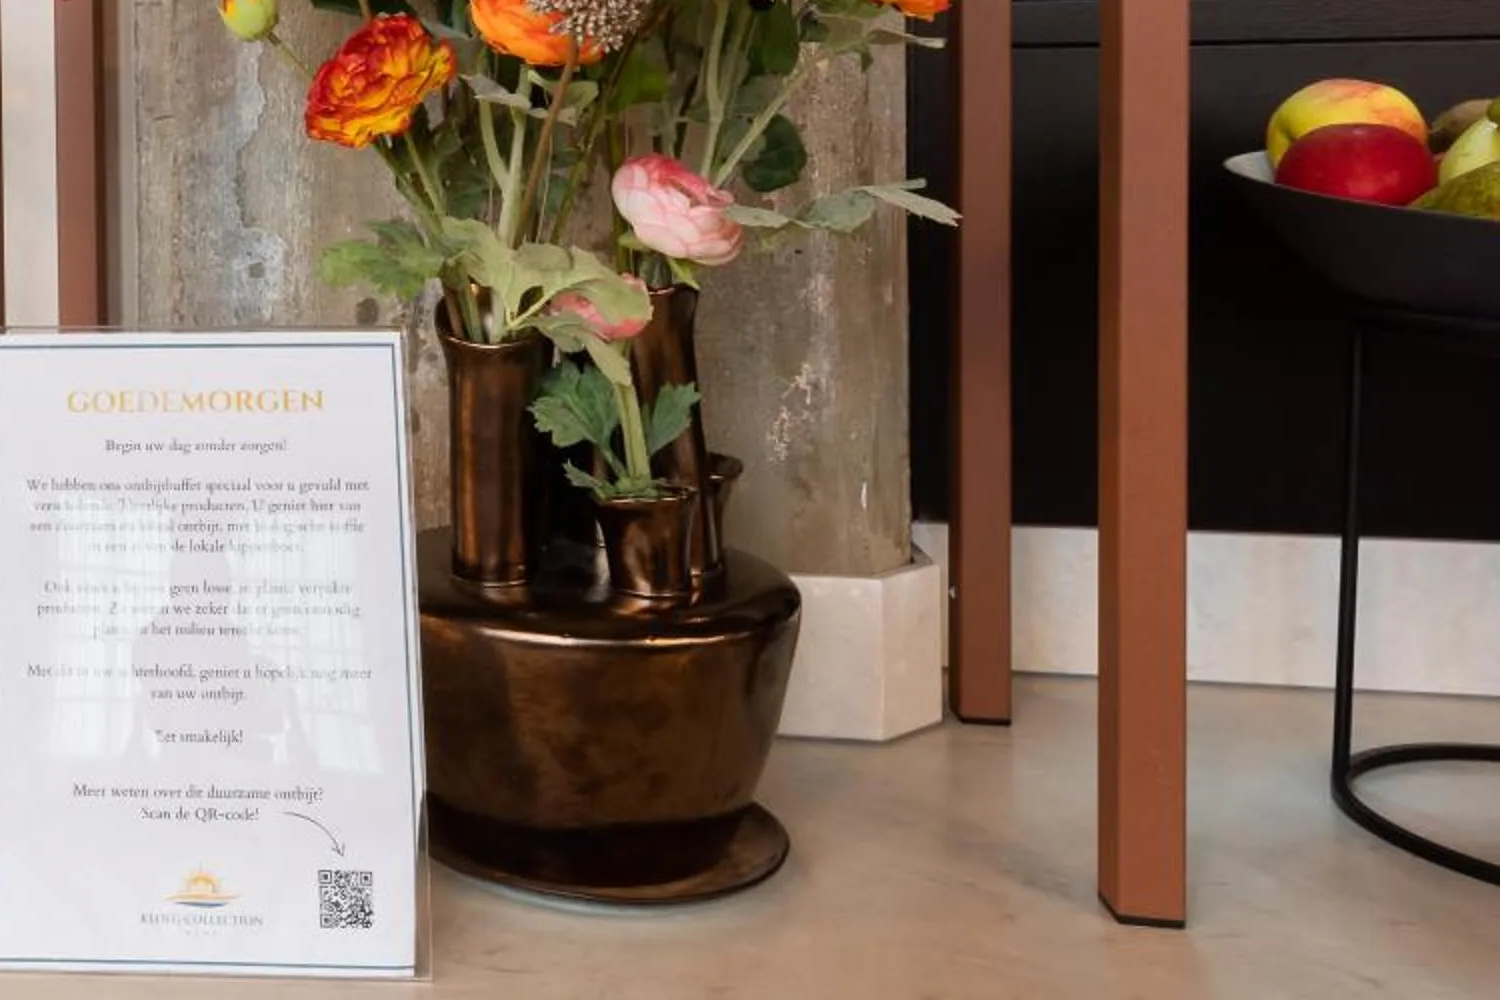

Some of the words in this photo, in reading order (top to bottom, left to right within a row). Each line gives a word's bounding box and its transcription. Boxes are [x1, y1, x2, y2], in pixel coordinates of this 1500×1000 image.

[67, 389, 325, 414] GOEDEMORGEN
[106, 439, 141, 454] Begin
[145, 441, 164, 451] uw
[169, 438, 191, 454] dag
[195, 439, 236, 452] zonder
[240, 439, 287, 454] zorgen!
[27, 479, 48, 491] We
[51, 477, 97, 491] hebben
[100, 482, 121, 491] ons
[124, 477, 201, 494] ontbijtbuffet
[205, 477, 251, 494] speciaal
[255, 482, 283, 491] voor
[287, 482, 296, 491] u
[299, 477, 342, 494] gevuld
[345, 480, 369, 491] met
[252, 498, 265, 512] U
[268, 498, 306, 515] geniet
[310, 498, 334, 512] hier
[339, 502, 362, 512] van
[30, 522, 51, 532] een
[227, 520, 249, 532] met
[171, 538, 185, 552] de
[189, 538, 225, 553] lokale
[169, 584, 199, 598] geen
[173, 605, 192, 615] we
[195, 601, 228, 615] zeker
[151, 620, 171, 635] het
[27, 662, 52, 677] Met
[117, 662, 197, 679] ahterhoofd,
[200, 664, 240, 682] geniet
[243, 668, 252, 678] u
[339, 668, 372, 680] meer
[151, 689, 173, 699] van
[177, 689, 196, 699] uw
[155, 729, 176, 743] Eet
[180, 728, 244, 747] smakelijk!
[73, 784, 106, 797] Meer
[111, 786, 149, 798] weten
[153, 788, 181, 798] over
[185, 784, 204, 798] dit
[208, 785, 271, 799] duurzame
[274, 785, 324, 804] ontbijt?
[141, 807, 171, 820] Scan
[175, 807, 191, 820] de
[194, 807, 259, 823] QR-code!
